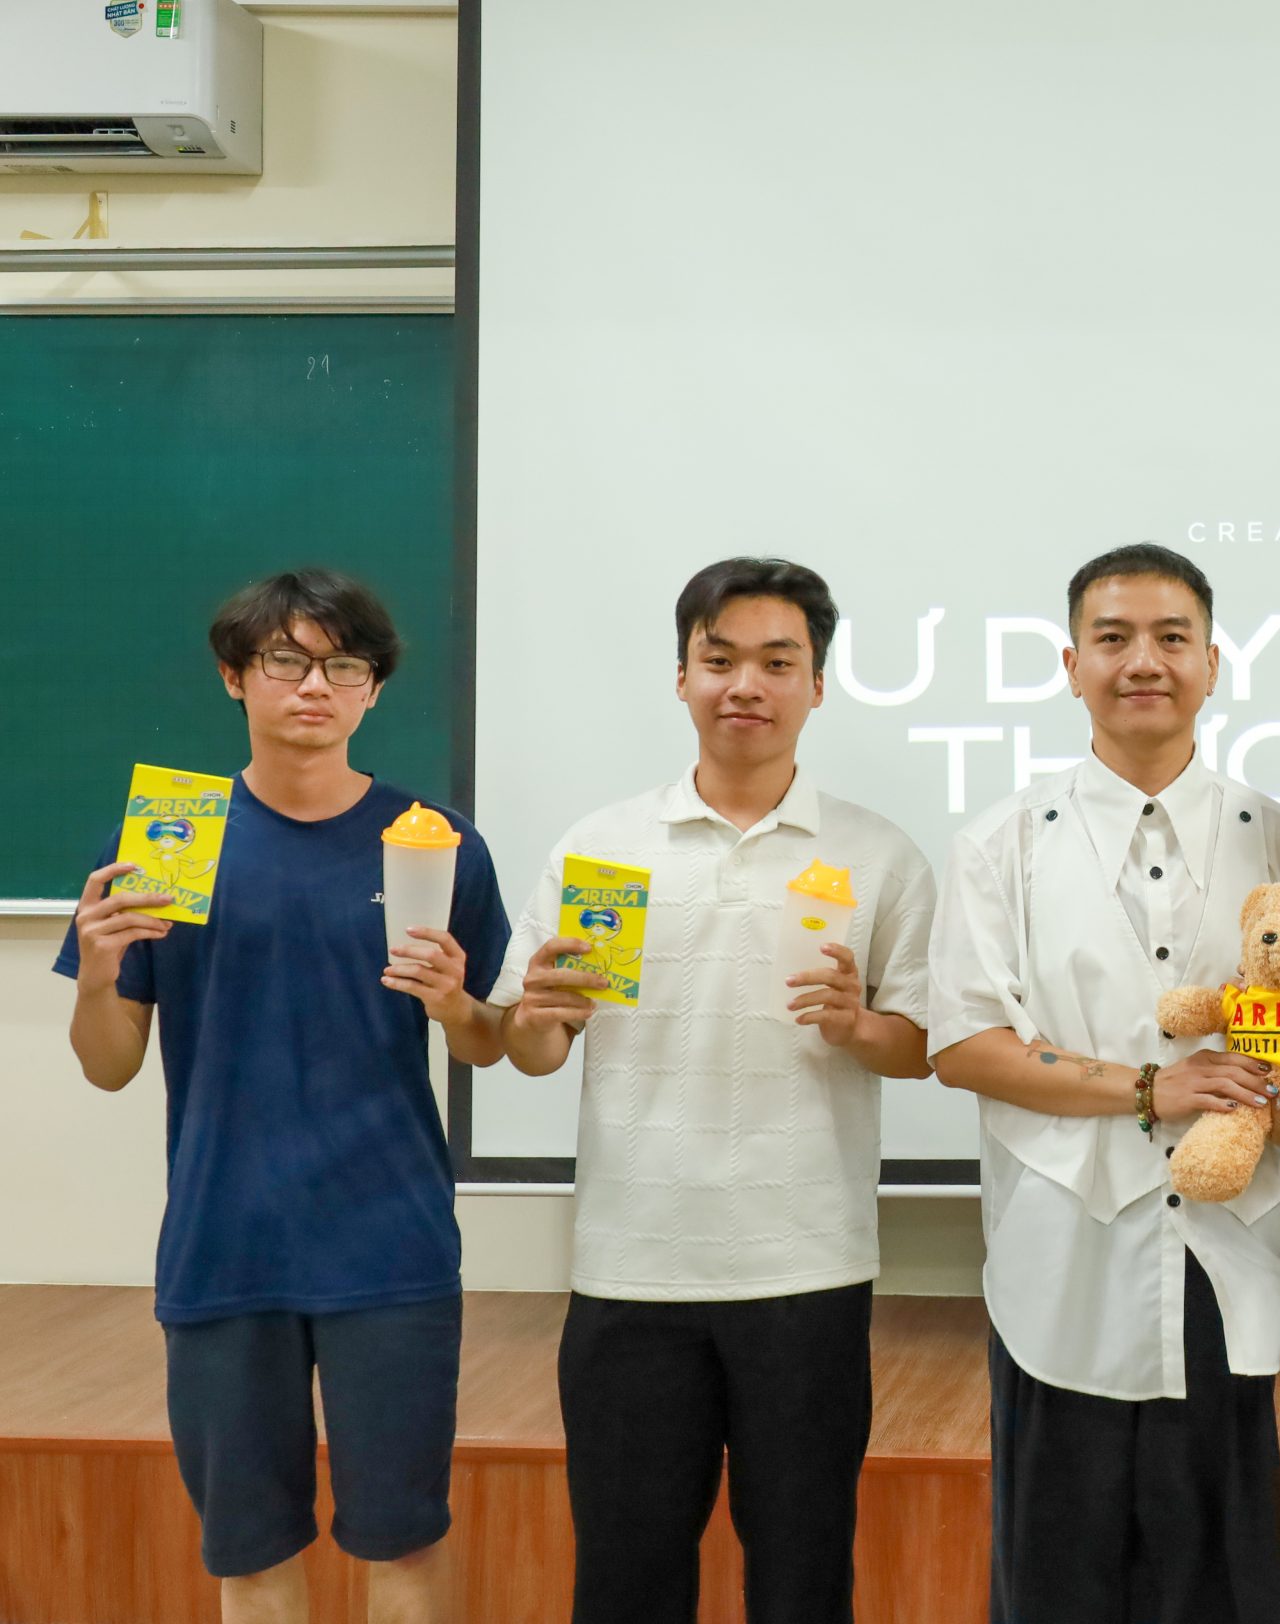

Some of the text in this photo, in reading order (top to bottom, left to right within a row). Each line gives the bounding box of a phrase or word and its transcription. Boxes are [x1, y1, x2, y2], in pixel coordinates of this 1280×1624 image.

[834, 607, 946, 707] Ư
[140, 799, 217, 815] ARENA
[571, 888, 639, 906] ARENA
